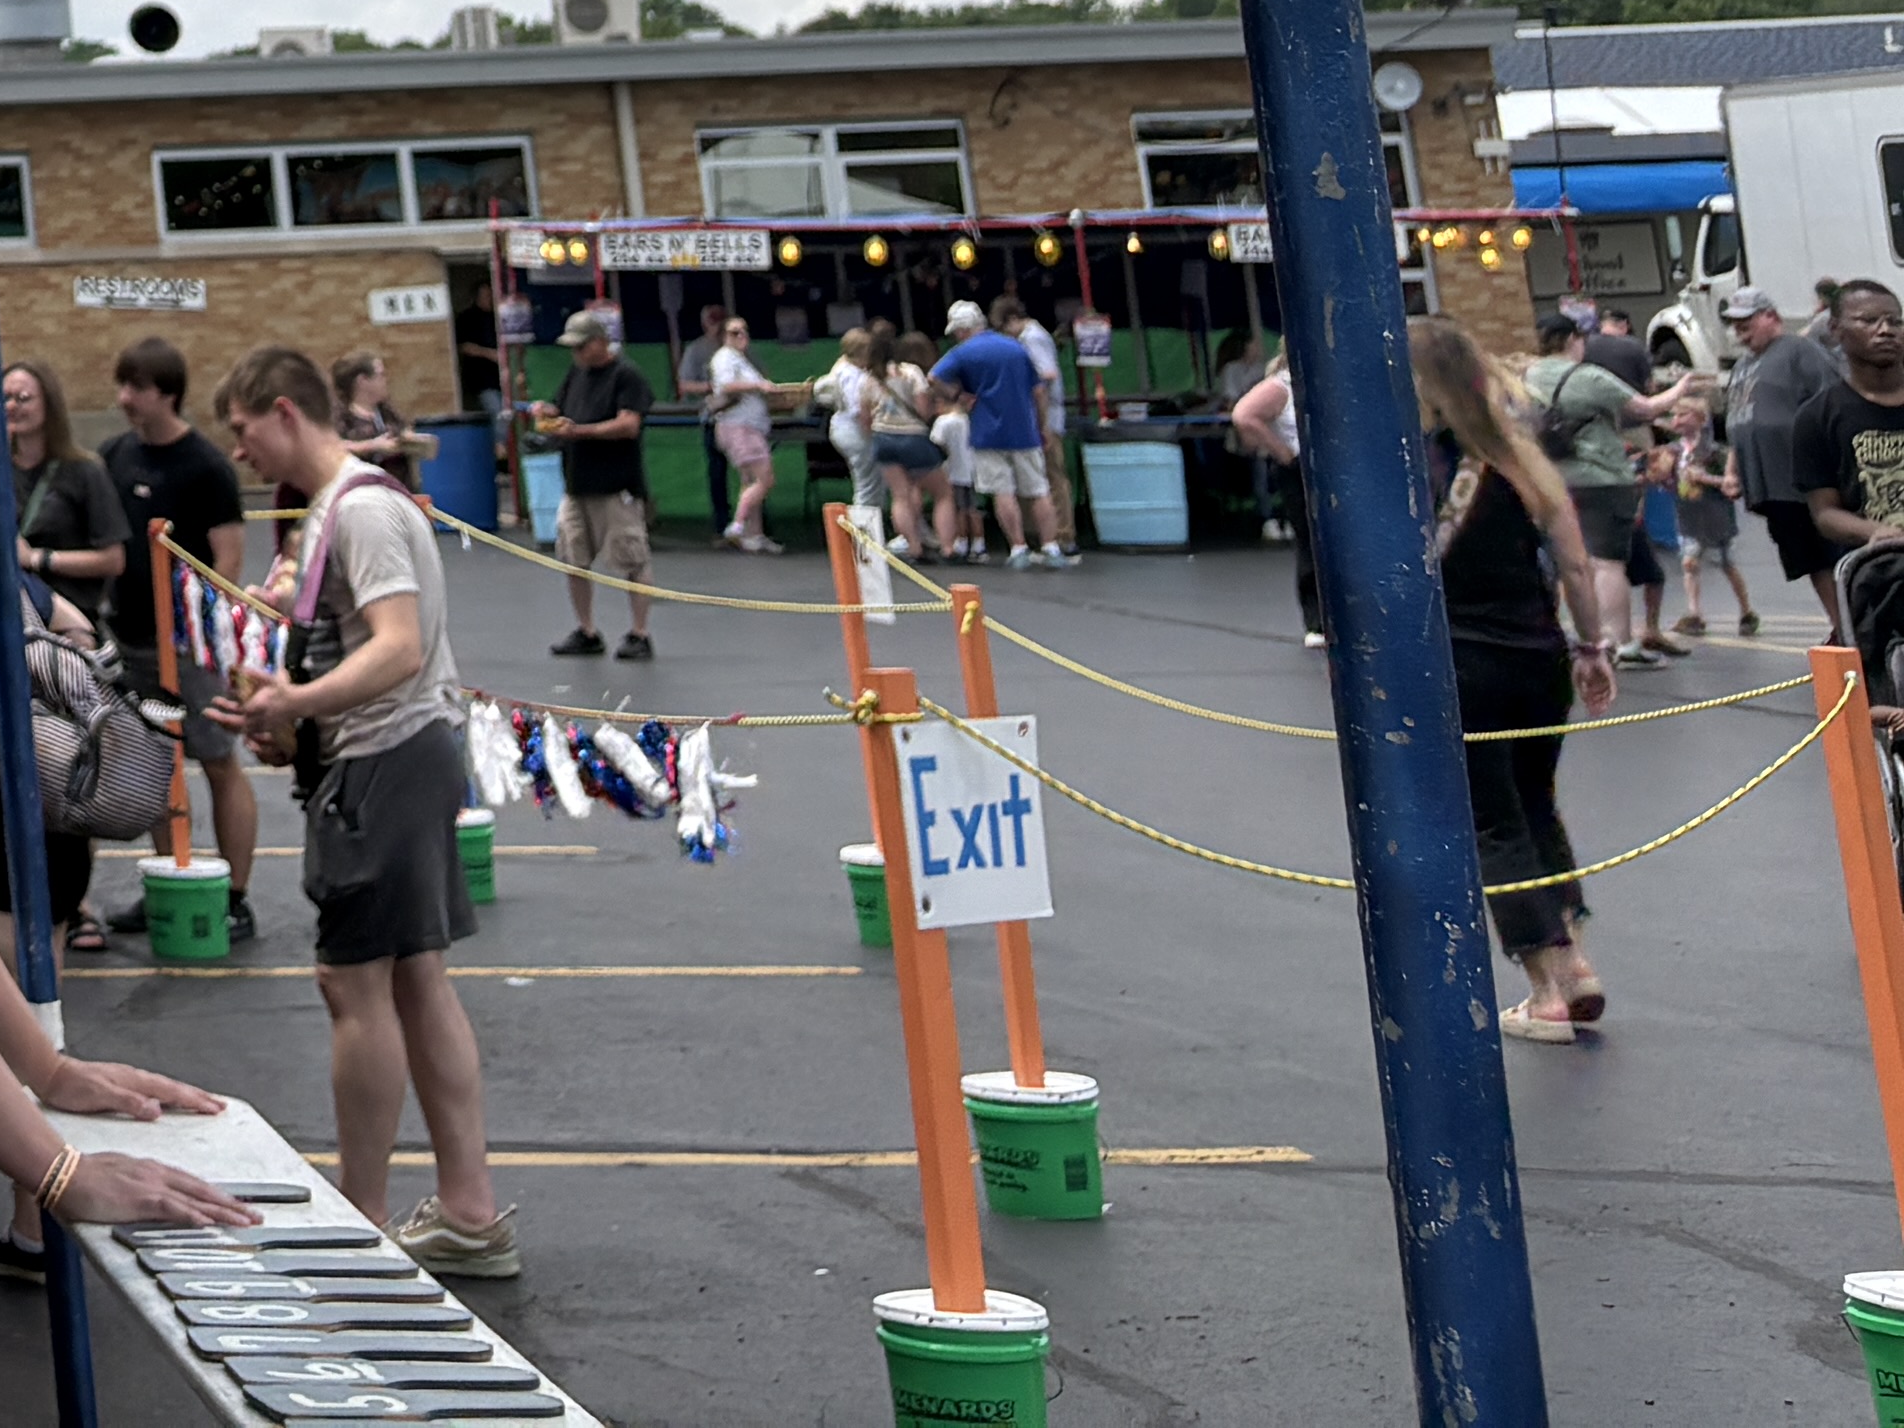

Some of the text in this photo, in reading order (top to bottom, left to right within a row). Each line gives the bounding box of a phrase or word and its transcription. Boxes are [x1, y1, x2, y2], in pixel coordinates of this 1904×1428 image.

[78, 275, 202, 297] RESTROOMS
[909, 755, 1031, 877] Exit
[153, 1248, 265, 1272] 10
[200, 1303, 309, 1322] 8
[216, 1334, 322, 1350] 7
[289, 1392, 409, 1413] 5
[894, 1386, 1015, 1420] MENARDS
